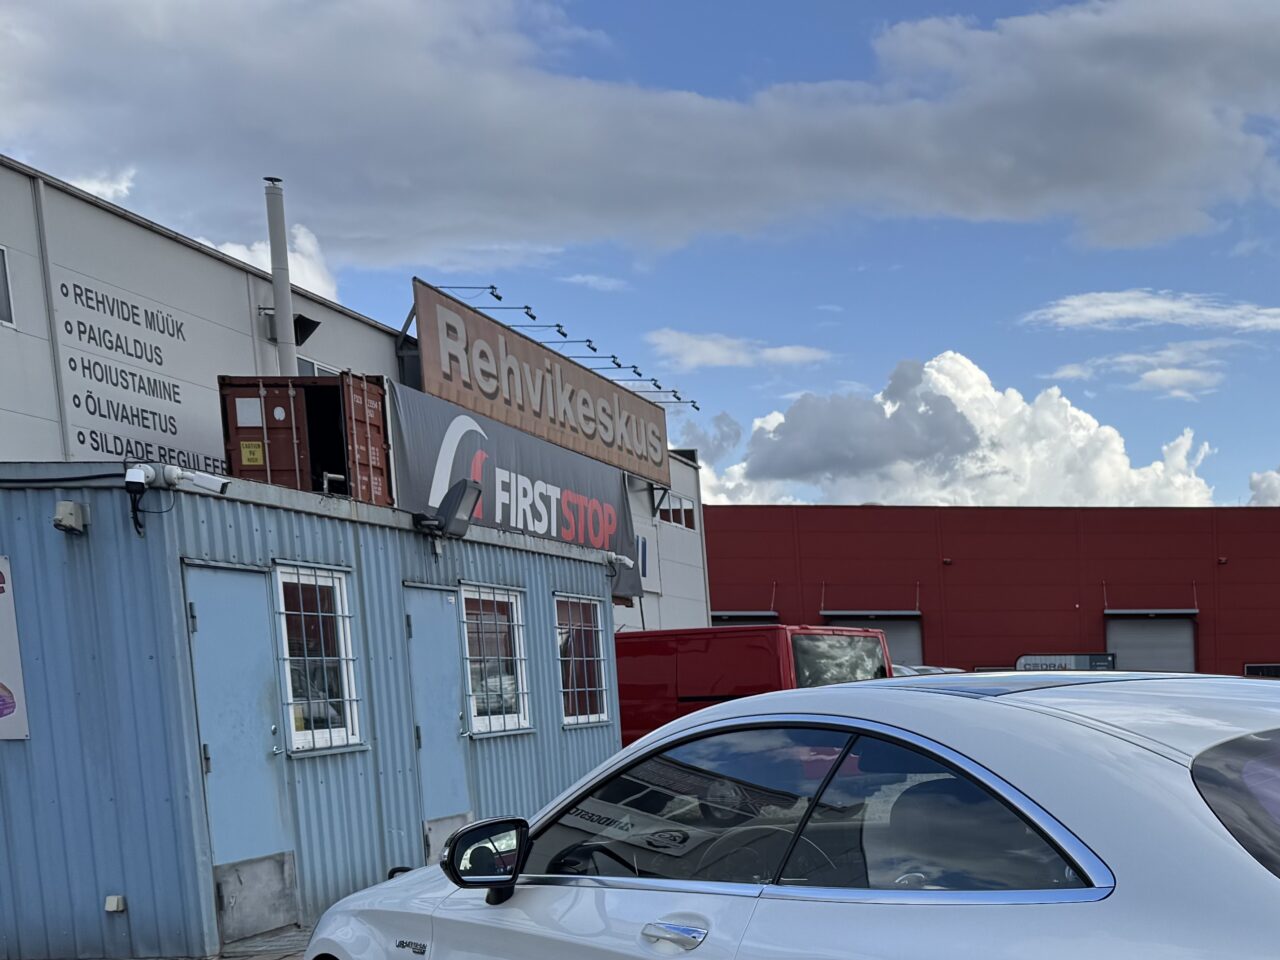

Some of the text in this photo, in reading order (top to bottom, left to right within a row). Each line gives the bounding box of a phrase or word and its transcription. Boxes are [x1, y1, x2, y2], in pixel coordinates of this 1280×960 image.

[72, 283, 187, 342] REHVIDE MÜÜK
[77, 320, 164, 367] PAIGALDUS
[81, 357, 182, 404] HOIUSTAMINE
[436, 303, 664, 466] Rehvikeskus
[85, 389, 178, 436] ÕLIVAHETUS
[90, 430, 155, 462] SILDADE
